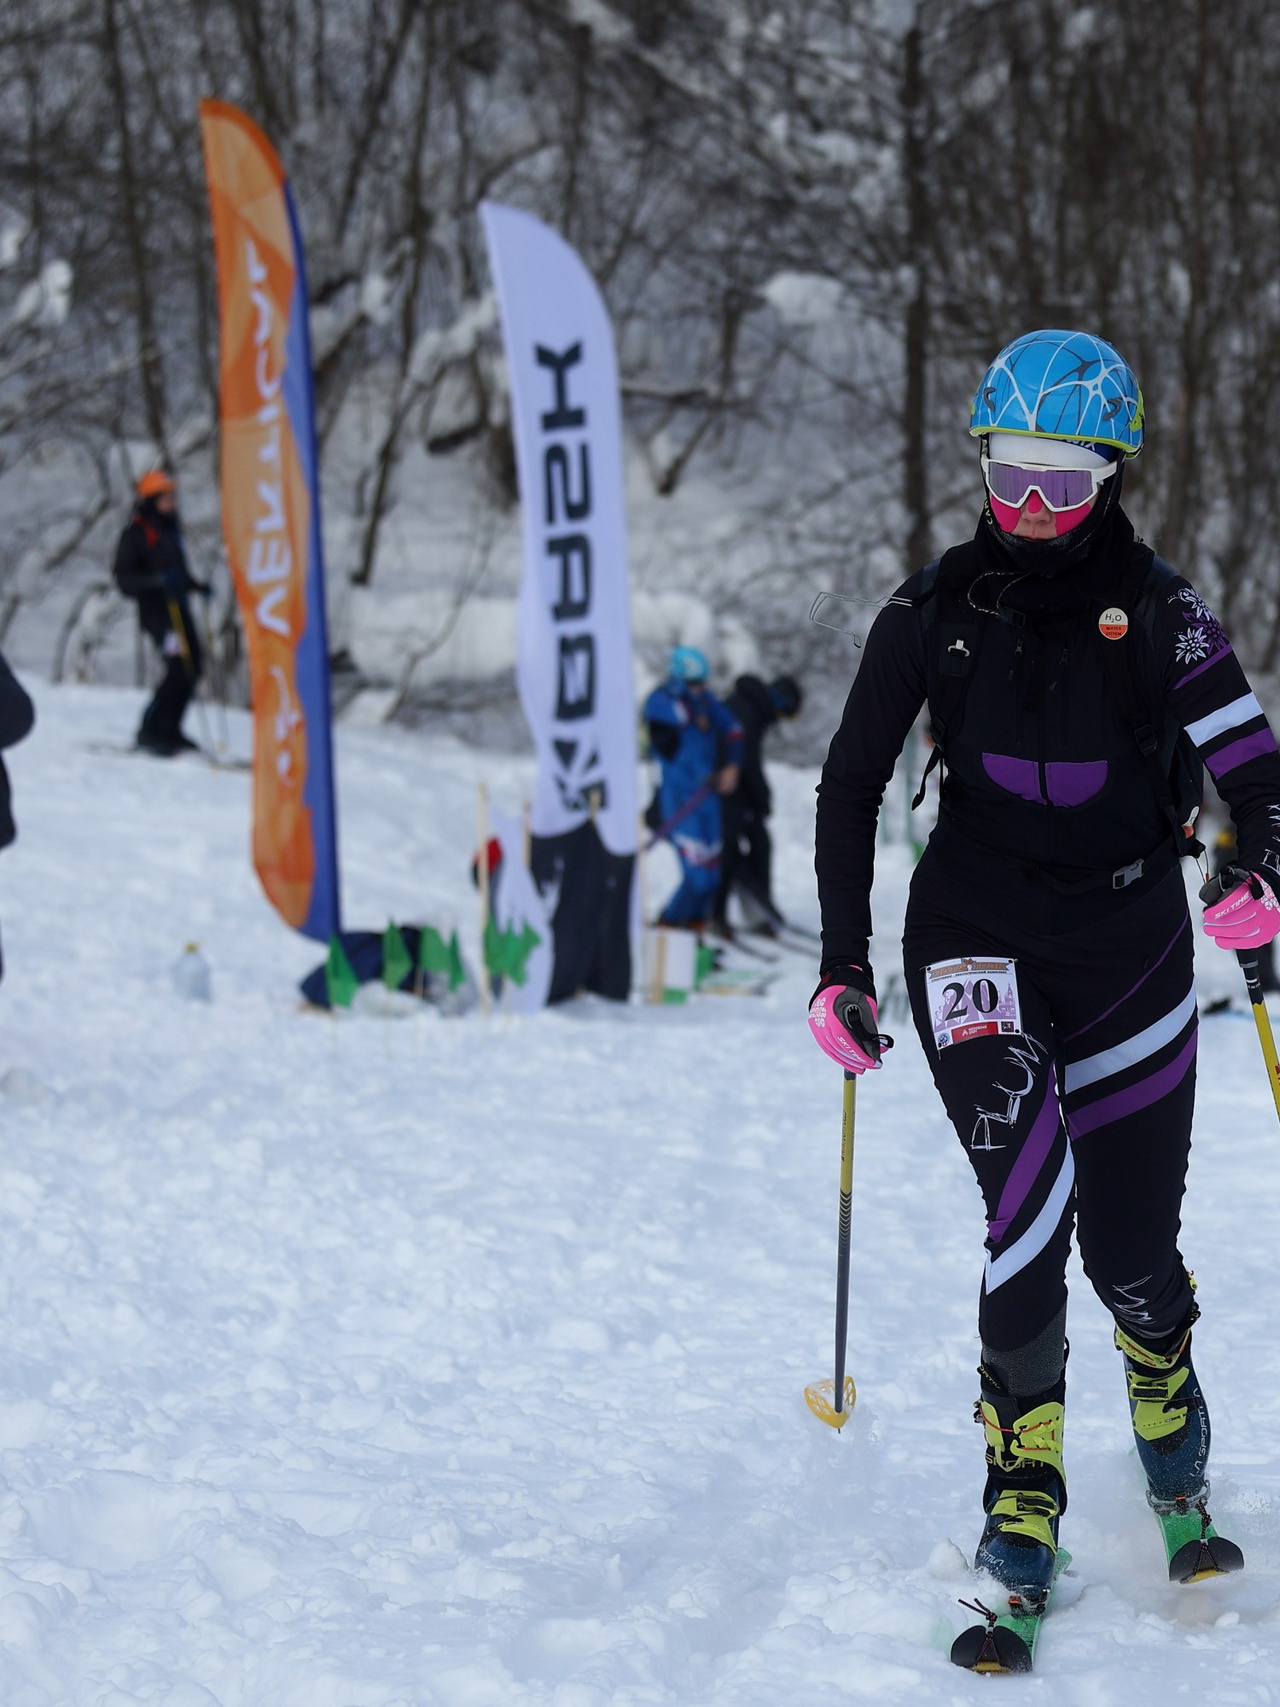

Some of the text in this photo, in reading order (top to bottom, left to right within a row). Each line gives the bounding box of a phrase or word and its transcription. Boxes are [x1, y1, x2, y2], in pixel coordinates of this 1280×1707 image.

[1214, 891, 1250, 920] SKI TIME
[942, 978, 998, 1021] 20
[1193, 1387, 1208, 1457] SPORTIA
